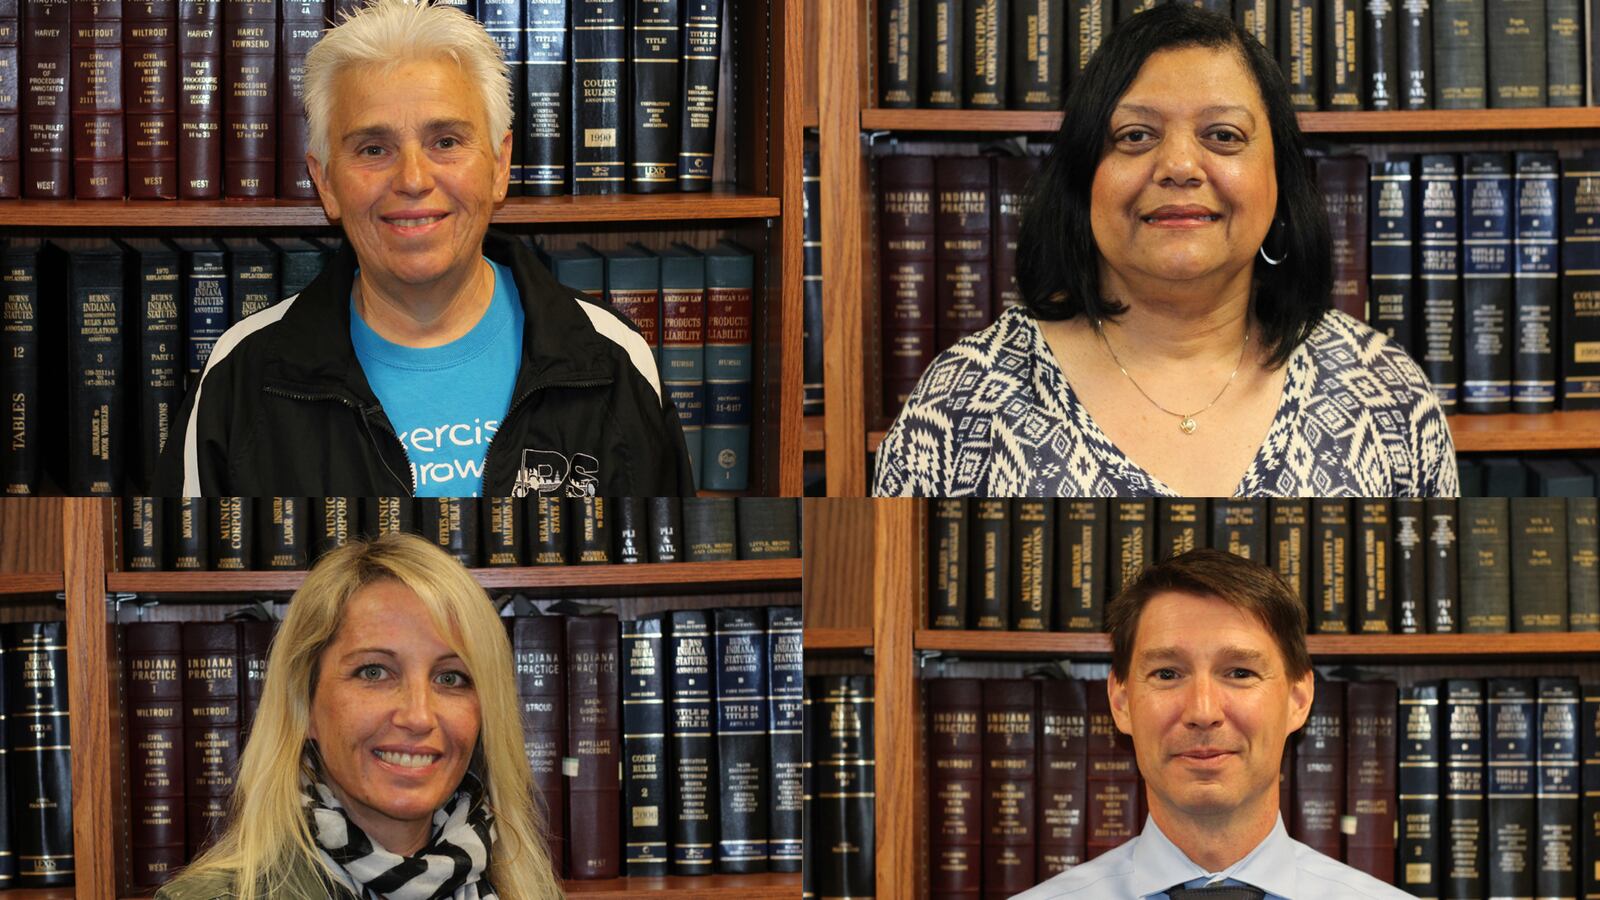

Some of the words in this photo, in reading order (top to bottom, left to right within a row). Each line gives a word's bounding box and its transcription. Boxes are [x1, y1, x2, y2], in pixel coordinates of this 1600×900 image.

[79, 29, 114, 38] WILTROUT
[132, 28, 168, 36] WILTROUT
[187, 30, 213, 38] HARVEY
[237, 28, 264, 36] HARVEY
[232, 40, 270, 48] TOWNSEND
[976, 6, 986, 76] MUNICIPAL
[584, 80, 618, 88] COURT
[584, 88, 616, 97] RULES
[590, 134, 612, 142] 1990
[645, 166, 665, 174] LEXIS
[37, 181, 54, 190] WEST
[90, 178, 108, 186] WEST
[144, 177, 163, 185] WEST
[190, 180, 209, 188] WEST
[240, 179, 259, 187] WEST
[886, 192, 929, 202] INDIANA
[941, 192, 985, 202] INDIANA
[886, 203, 928, 213] PRACTICE
[940, 203, 984, 213] PRACTICE
[195, 288, 222, 296] INDIANA
[148, 302, 176, 310] INDIANA
[194, 297, 224, 306] STATUTES
[4, 302, 32, 311] INDIANA
[83, 303, 116, 312] INDIANA
[4, 311, 33, 320] STATUTES
[665, 318, 701, 326] PRODUCTS
[709, 316, 748, 326] PRODUCTS
[664, 331, 700, 340] LIABILITY
[708, 329, 748, 340] LIABILITY
[13, 346, 24, 358] 12
[160, 344, 166, 352] 6
[97, 353, 102, 362] 3
[12, 393, 25, 450] TABLES
[101, 404, 109, 436] VEHICLES
[92, 418, 100, 456] INSURANCE
[400, 418, 499, 452] xercis
[101, 437, 109, 460] MOTOR
[450, 504, 460, 530] PUBLIC
[492, 504, 502, 532] PUBLIC
[550, 509, 560, 534] STATE
[182, 510, 192, 538] MOTOR
[503, 506, 513, 546] RAILROADS
[284, 518, 294, 544] LABOR
[439, 518, 449, 545] OFFICES
[540, 518, 549, 542] REAL
[584, 518, 594, 541] STATE
[622, 530, 635, 538] PLI
[1334, 538, 1344, 574] AFFAIRS
[1022, 534, 1032, 602] MUNICIPAL
[1323, 542, 1333, 586] PROPERTY
[1032, 527, 1042, 612] CORPORATIONS
[1334, 576, 1344, 604] STATE
[1324, 588, 1334, 612] REAL
[680, 639, 702, 648] BURNS
[729, 636, 750, 645] BURNS
[778, 636, 800, 644] BURNS
[677, 647, 706, 656] INDIANA
[726, 646, 754, 654] INDIANA
[775, 644, 803, 653] INDIANA
[188, 658, 232, 668] INDIANA
[517, 654, 559, 664] INDIANA
[676, 656, 708, 666] STATUTES
[724, 655, 756, 664] STATUTES
[133, 660, 176, 669] INDIANA
[188, 669, 232, 678] PRACTICE
[517, 665, 560, 674] PRACTICE
[133, 671, 176, 680] PRACTICE
[137, 708, 174, 717] WILTROUT
[193, 707, 230, 716] WILTROUT
[934, 714, 976, 722] INDIANA
[987, 714, 1030, 722] INDIANA
[1044, 716, 1084, 726] INDIANA
[934, 724, 976, 733] PRACTICE
[987, 724, 1030, 733] PRACTICE
[1044, 726, 1084, 736] PRACTICE
[633, 764, 656, 772] RULES
[641, 788, 648, 798] 2
